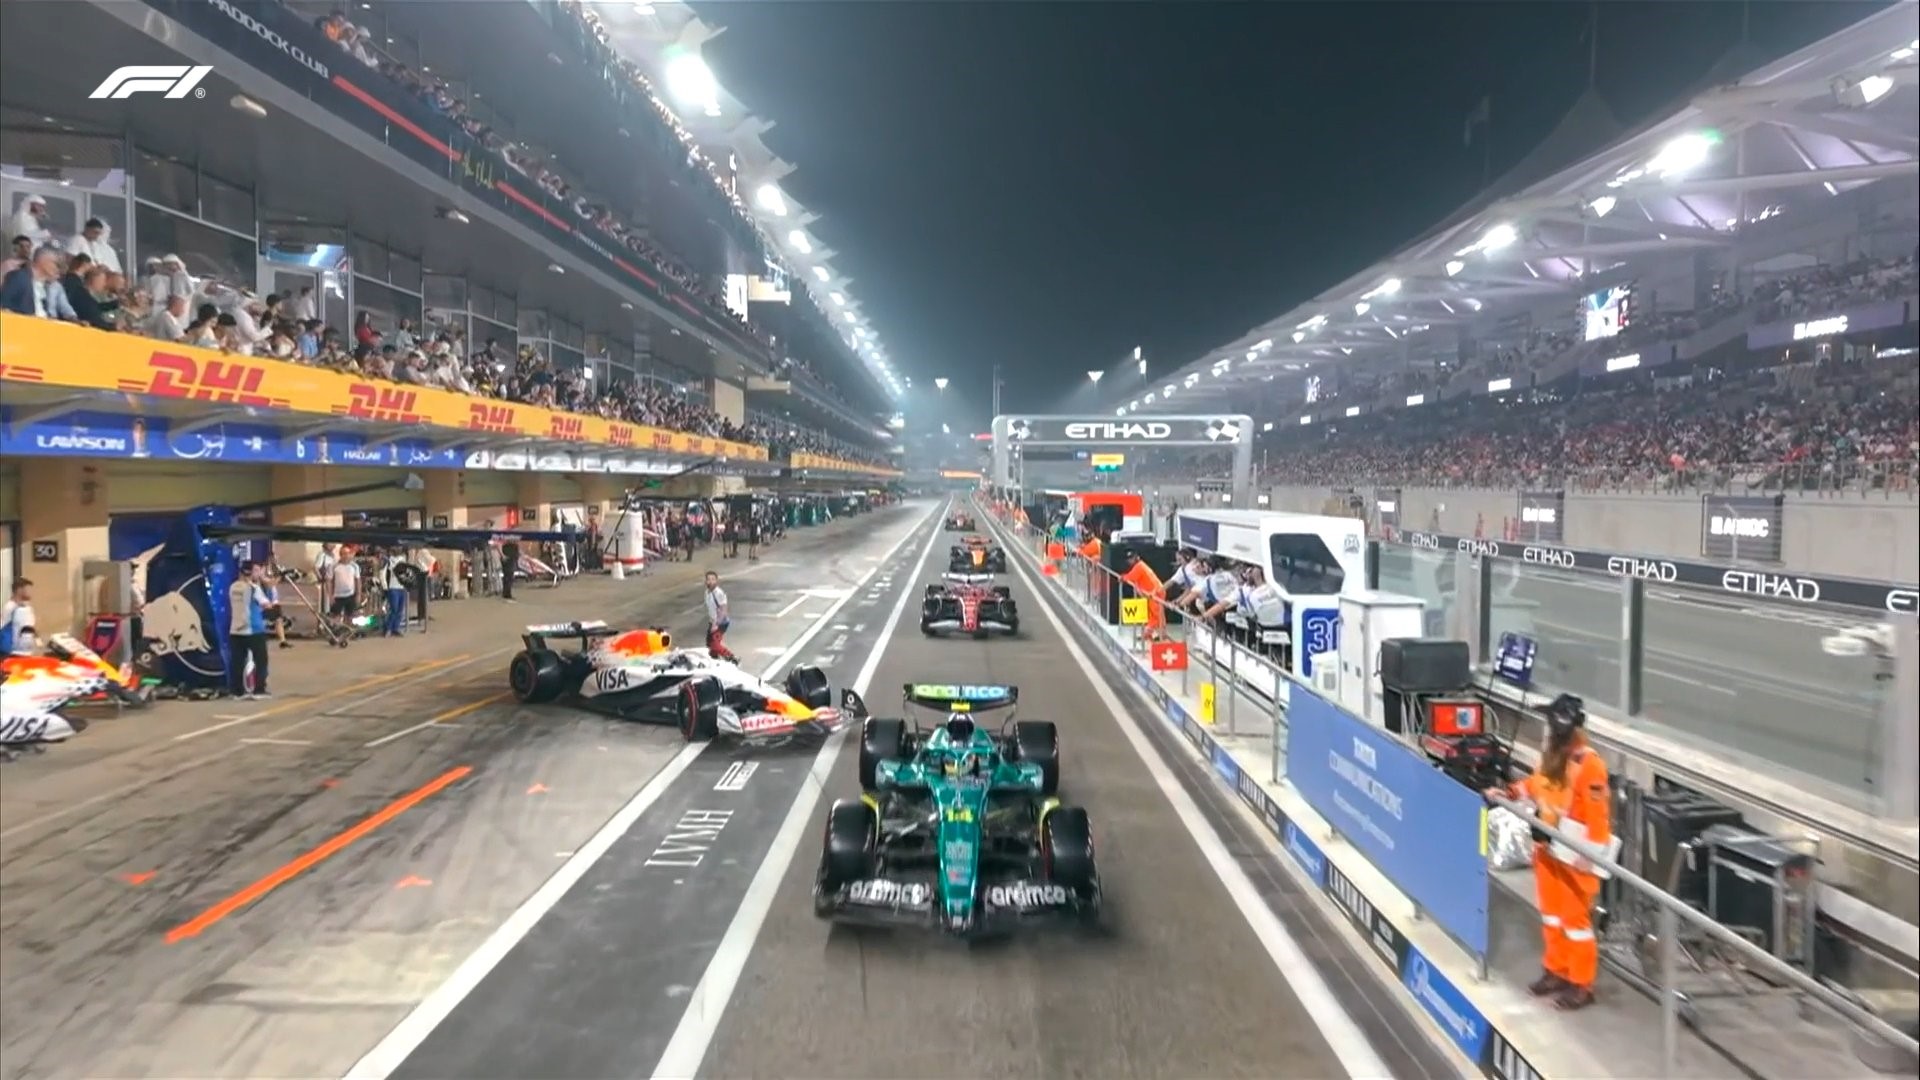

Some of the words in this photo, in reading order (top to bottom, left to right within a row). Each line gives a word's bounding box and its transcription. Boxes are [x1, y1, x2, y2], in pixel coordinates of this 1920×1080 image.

[208, 0, 289, 53] ADDOCK
[291, 46, 329, 79] CLUB
[148, 351, 270, 408] DHL
[349, 383, 420, 424] DHL
[470, 403, 517, 434] DHL
[551, 416, 584, 440] DHL
[1065, 423, 1171, 439] ETIHAD
[37, 435, 126, 450] LAWSON
[35, 544, 56, 558] 30
[1411, 533, 1439, 549] ETIHAD
[1458, 538, 1499, 557] ETIHAD
[1523, 546, 1575, 568] ETIHAD
[1608, 556, 1677, 582] ETIHAD
[1722, 570, 1820, 601] ETIHAD
[596, 668, 629, 690] VISA
[644, 810, 734, 866] LVMH
[850, 879, 925, 905] aramco
[991, 881, 1066, 907] aramco
